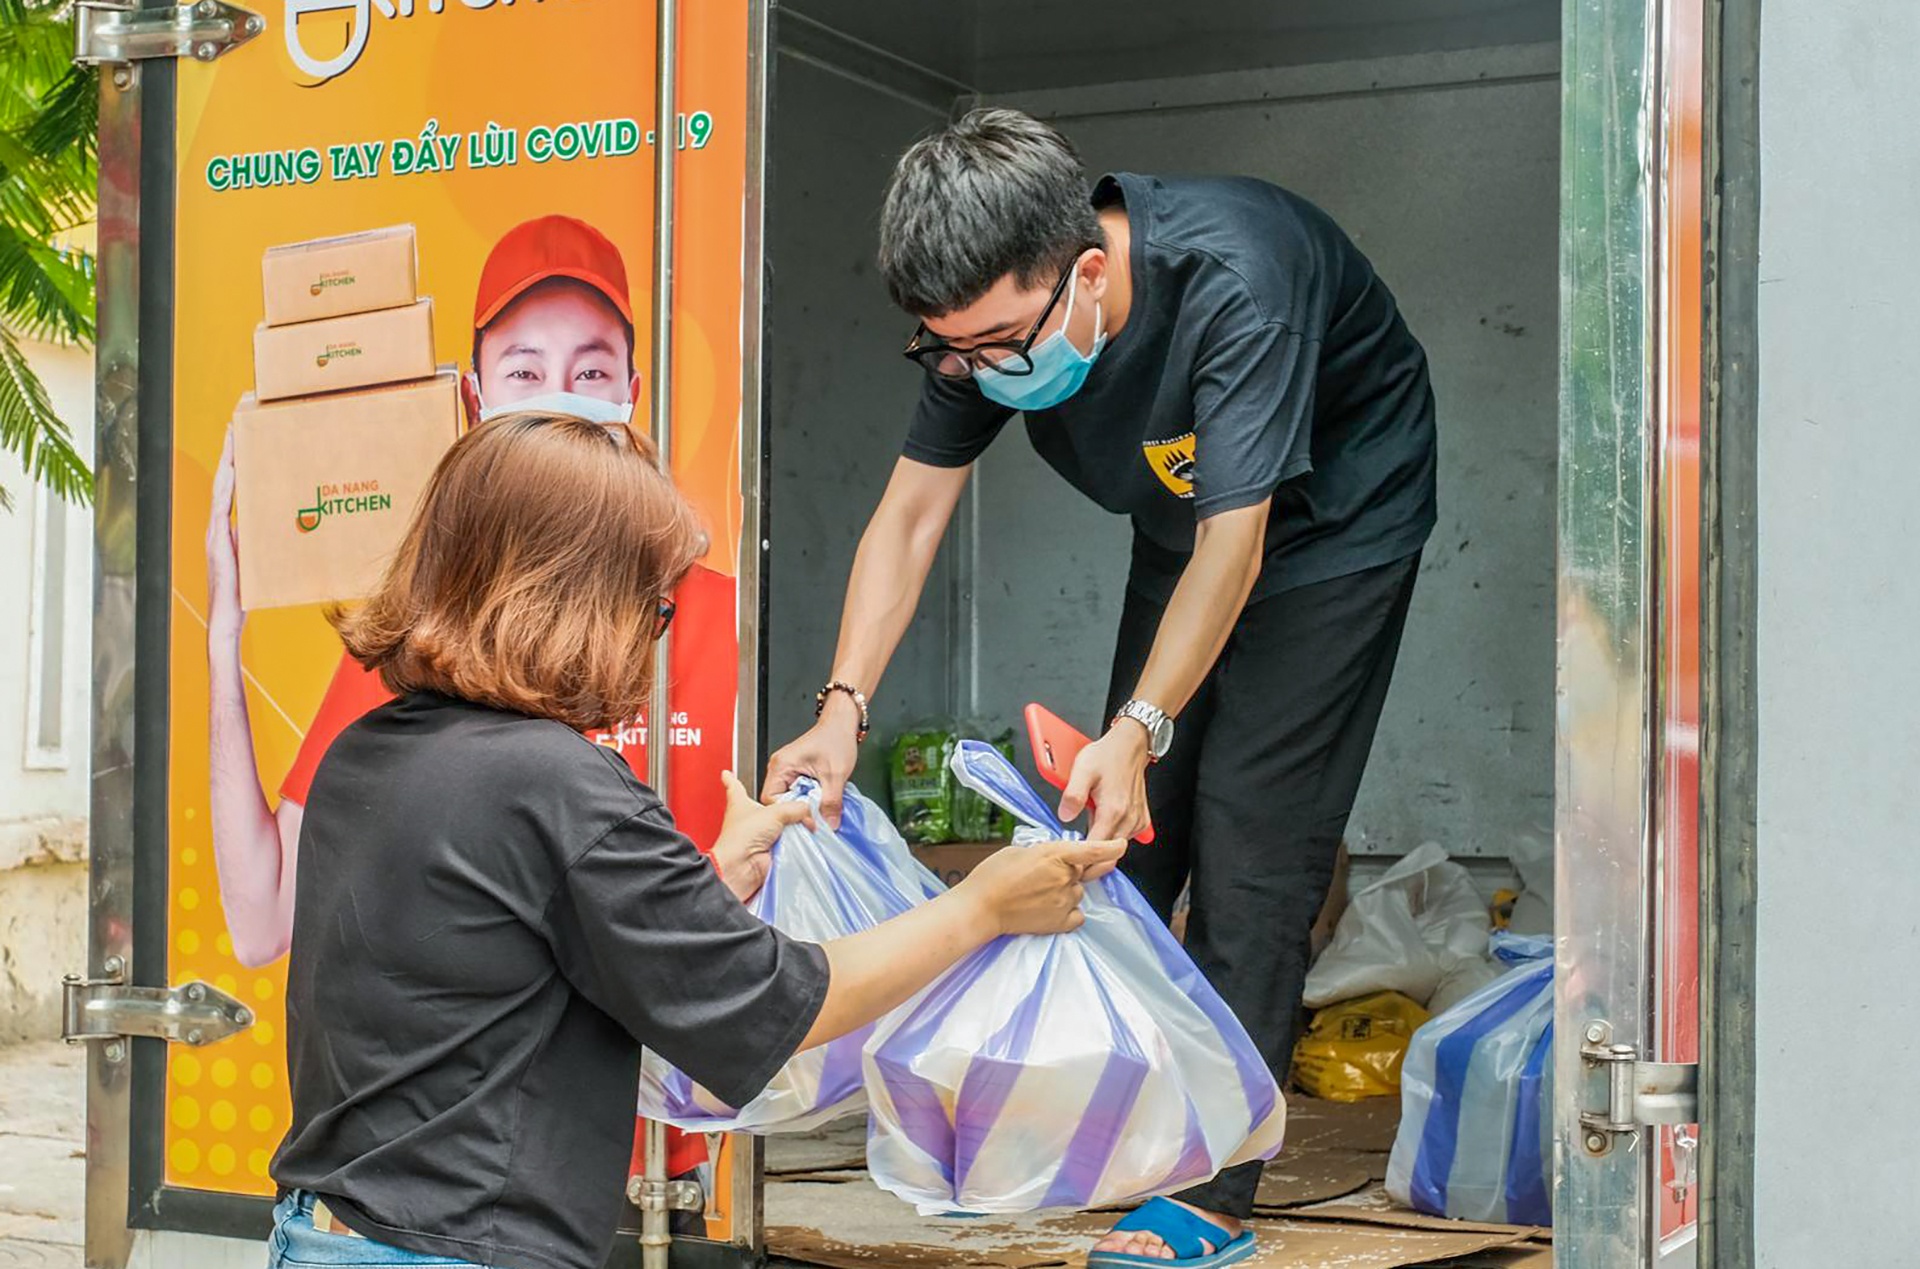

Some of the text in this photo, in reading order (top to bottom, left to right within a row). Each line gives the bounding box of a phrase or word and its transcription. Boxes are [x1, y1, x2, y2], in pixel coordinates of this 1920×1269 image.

[207, 149, 321, 190] CHUNG
[330, 143, 383, 179] TAY
[391, 118, 461, 174] ĐẨY
[468, 122, 517, 167] LÙI
[525, 119, 639, 162] COVID
[322, 480, 379, 496] DA NANG
[320, 494, 391, 515] KITCHEN
[621, 727, 701, 746] KITEN
